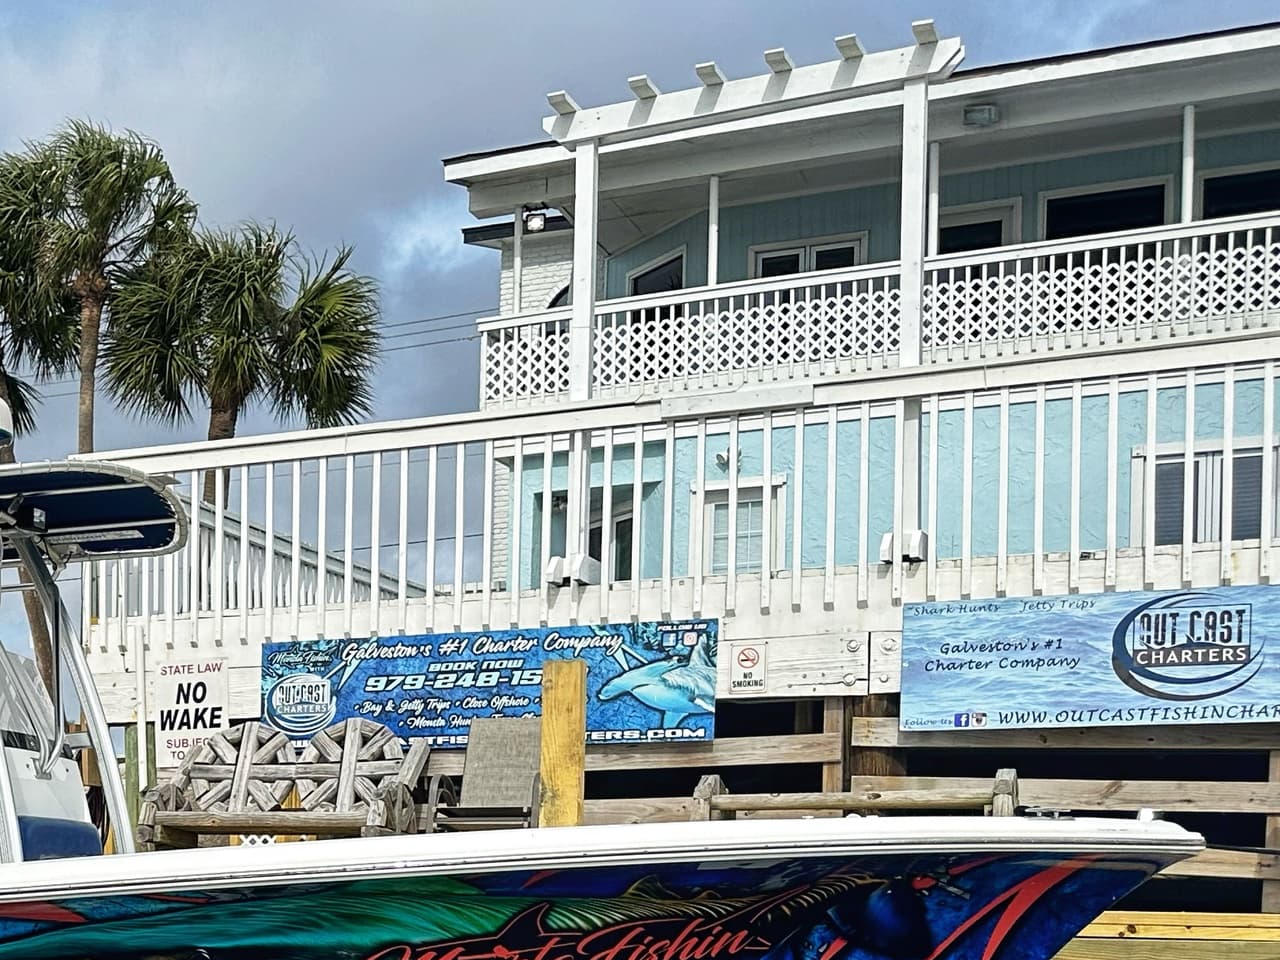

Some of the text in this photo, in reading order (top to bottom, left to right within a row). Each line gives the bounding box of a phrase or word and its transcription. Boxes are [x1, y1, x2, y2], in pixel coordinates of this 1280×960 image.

[913, 599, 1096, 616] Shark Hunts Jetty Trips
[1139, 609, 1246, 646] OUT CAST
[342, 632, 624, 662] Galveston's #1 Charter Company
[939, 638, 1063, 655] Galveston's #1
[924, 656, 1081, 672] Charter Company
[1136, 647, 1247, 665] CHARTERS
[160, 662, 224, 676] STATE LAW
[428, 661, 478, 673] BOOK
[743, 671, 753, 679] NO
[364, 669, 543, 692] 979-248-15
[732, 679, 764, 688] SMOKING
[176, 681, 207, 705] NO
[276, 704, 328, 713] CHARTERS
[359, 701, 382, 716] Bay
[426, 698, 451, 714] Trips
[462, 697, 488, 709] Close
[490, 694, 529, 712] Offshore
[160, 706, 223, 732] WAKE
[406, 716, 446, 728] Monsta
[449, 715, 477, 728] Hun
[170, 750, 186, 760] TO
